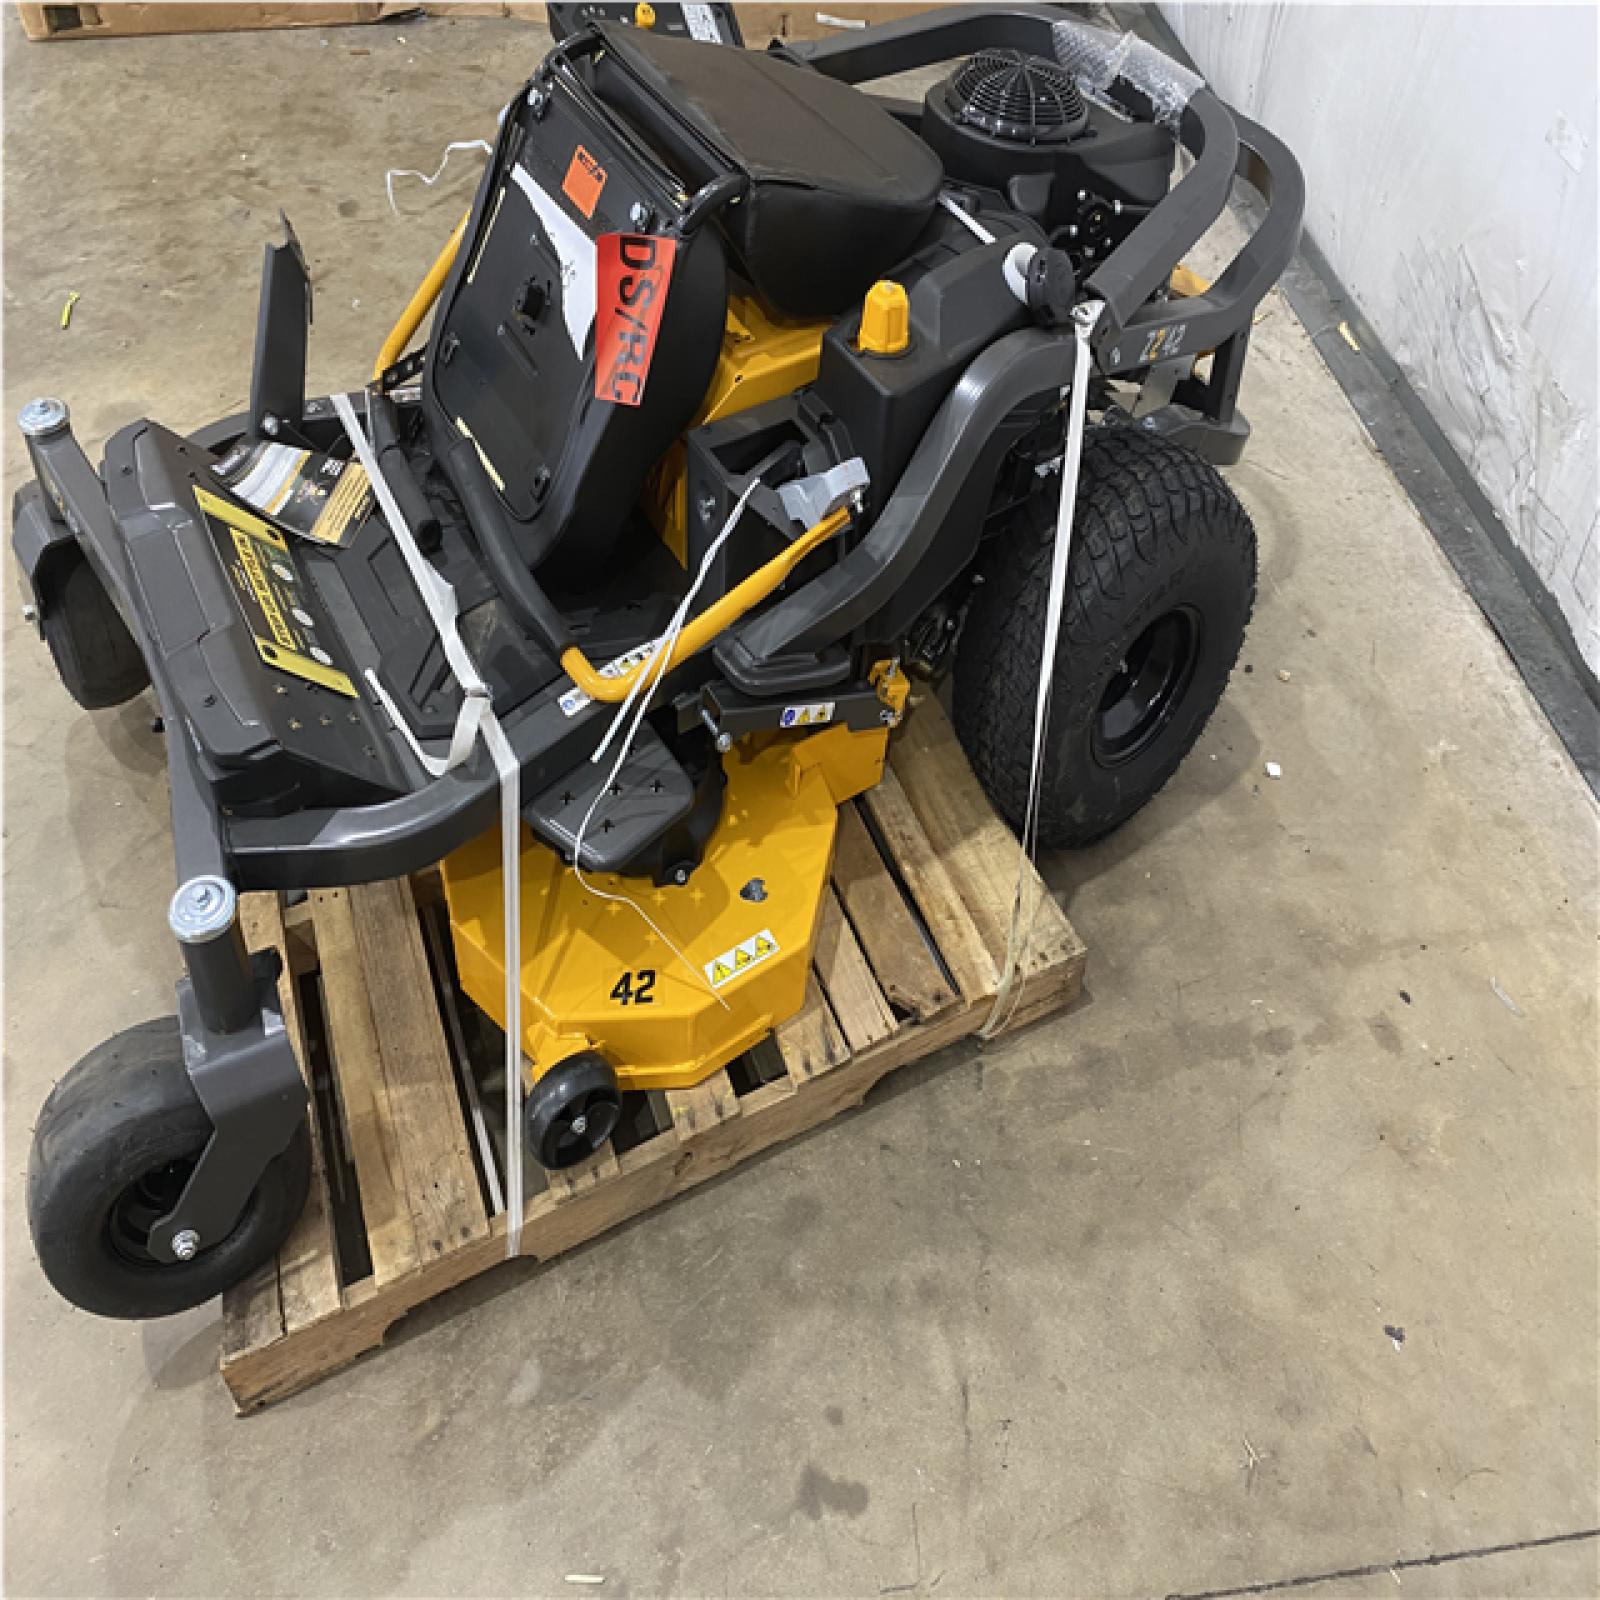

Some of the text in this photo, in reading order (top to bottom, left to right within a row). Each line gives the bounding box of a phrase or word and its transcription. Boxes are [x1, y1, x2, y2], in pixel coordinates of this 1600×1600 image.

[612, 237, 656, 403] DS/RC
[1139, 324, 1186, 362] Z242
[610, 969, 656, 1006] 42
